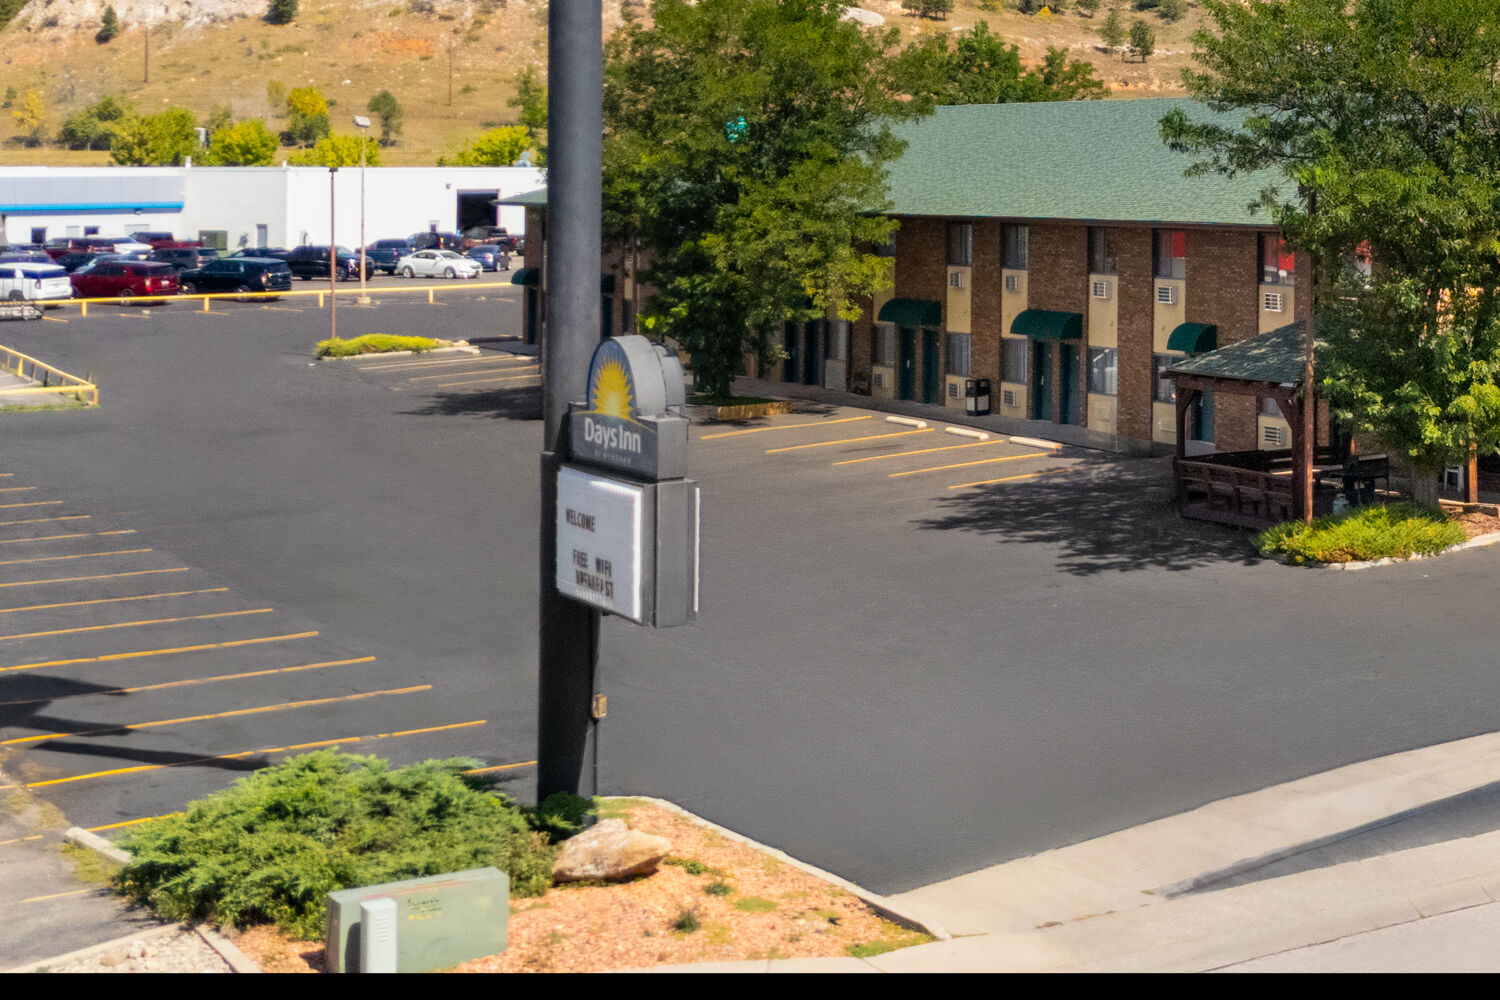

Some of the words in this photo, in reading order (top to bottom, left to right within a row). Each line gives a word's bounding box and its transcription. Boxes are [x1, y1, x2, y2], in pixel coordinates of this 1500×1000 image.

[584, 417, 618, 450] Days
[619, 424, 641, 454] Inn
[565, 508, 596, 533] WELCOME
